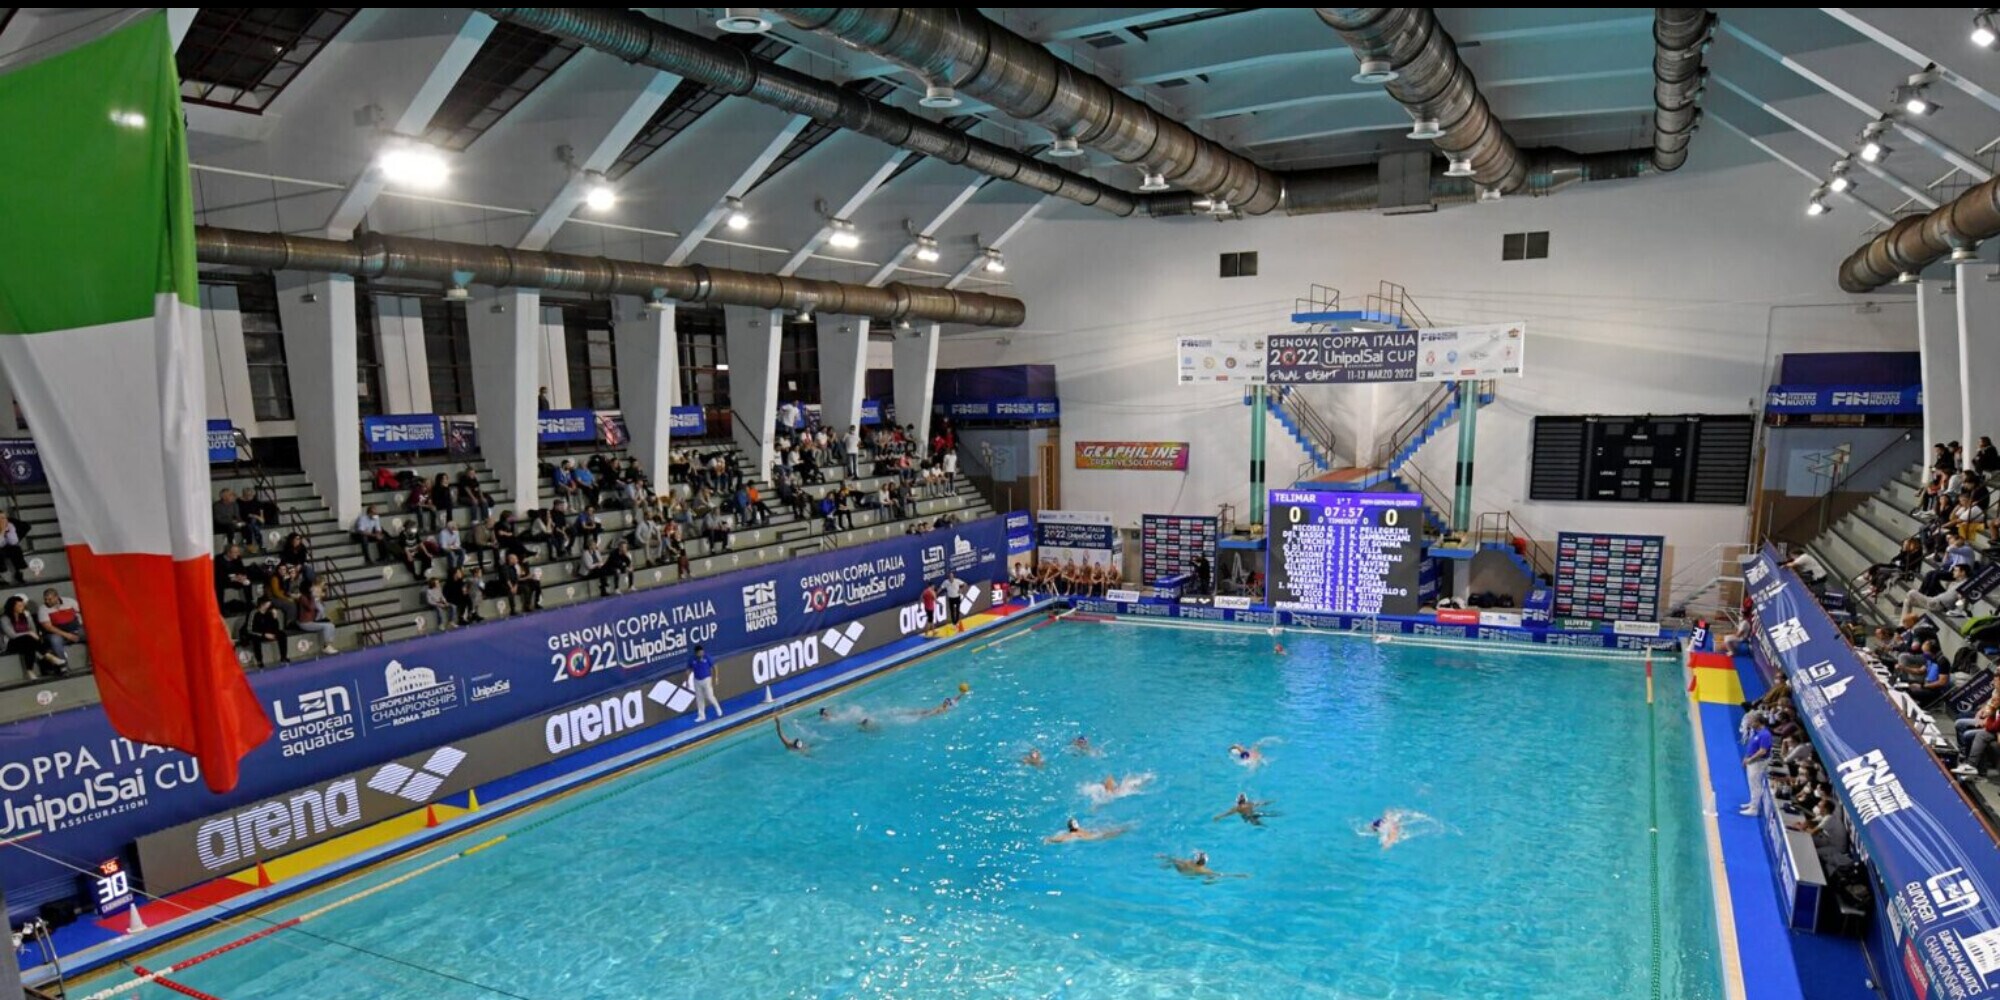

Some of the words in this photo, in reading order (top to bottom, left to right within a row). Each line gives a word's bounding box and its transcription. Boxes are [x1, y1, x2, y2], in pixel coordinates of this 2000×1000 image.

[1270, 338, 1319, 348] GENOVA
[1322, 336, 1369, 349] COPPA
[1373, 334, 1415, 347] ITALIA
[1270, 348, 1318, 366] 2022
[1325, 348, 1384, 368] UnipolSai
[1387, 351, 1416, 363] CUP
[1347, 370, 1366, 380] 11-13
[1367, 370, 1393, 379] MARZO
[1394, 369, 1414, 379] 2022
[1831, 392, 1869, 406] FIN
[370, 425, 409, 442] FIN
[1129, 458, 1174, 467] SOLUTIONS
[1275, 493, 1316, 503] TELIMAR
[1289, 506, 1301, 523] 0
[1324, 506, 1364, 518] 07:57
[1385, 508, 1398, 526] 0
[1328, 517, 1359, 525] TIMEOUT
[1282, 530, 1297, 538] DEL
[1359, 534, 1411, 542] GAMBACCIANI
[1292, 524, 1325, 532] NICOSIA
[1359, 527, 1409, 535] PELLEGRINI
[1297, 537, 1335, 545] TURCHINI
[921, 544, 945, 564] LEN
[1366, 554, 1403, 562] PANERAI
[800, 569, 842, 589] GENOVA
[843, 561, 875, 581] COPPA
[876, 554, 905, 574] ITALIA
[1358, 560, 1390, 568] RAVINA
[1358, 567, 1389, 575] FRACAS
[1286, 582, 1323, 591] MAXWELL
[1355, 586, 1398, 595] BITTARELLO
[1290, 576, 1324, 584] FABIANO
[1358, 580, 1387, 588] FIGARI
[742, 579, 777, 607] FIN
[802, 583, 844, 614] 2022
[846, 576, 887, 602] UnipolSai
[887, 573, 906, 589] CUP
[1153, 587, 1175, 598] FIN
[1303, 589, 1323, 597] DICO
[1358, 593, 1384, 601] GITTO
[1299, 596, 1323, 604] BASIC
[1358, 599, 1383, 607] GUIDI
[1357, 606, 1381, 614] VALLE
[1179, 607, 1204, 617] FIN
[1522, 608, 1550, 621] FIN
[547, 621, 613, 650] GENOVA
[616, 609, 669, 639] COPPA
[672, 599, 716, 625] ITALIA
[746, 615, 778, 633] NUOTO
[1413, 623, 1442, 635] FIN
[1546, 633, 1578, 647] FIN
[1693, 626, 1705, 641] 30
[551, 642, 618, 683] 2022
[621, 628, 687, 666] UnipolSai
[690, 622, 718, 644] CUP
[752, 635, 819, 684] arena
[471, 679, 510, 699] UnipolSai
[273, 685, 351, 727] LEN
[370, 694, 416, 713] EUROPEAN
[416, 683, 456, 701] AQUATICS
[371, 693, 458, 723] CHAMPIONSHIPS
[392, 714, 421, 727] ROMA
[421, 707, 441, 720] 2022
[545, 689, 645, 754] arena
[282, 726, 355, 758] aquatics
[0, 745, 101, 791] OPPA
[1836, 748, 1896, 798] FIN
[59, 798, 149, 830] ASSICURAZIONI
[197, 777, 360, 871] arena
[96, 870, 129, 905] 30
[1926, 866, 1981, 917] LEN
